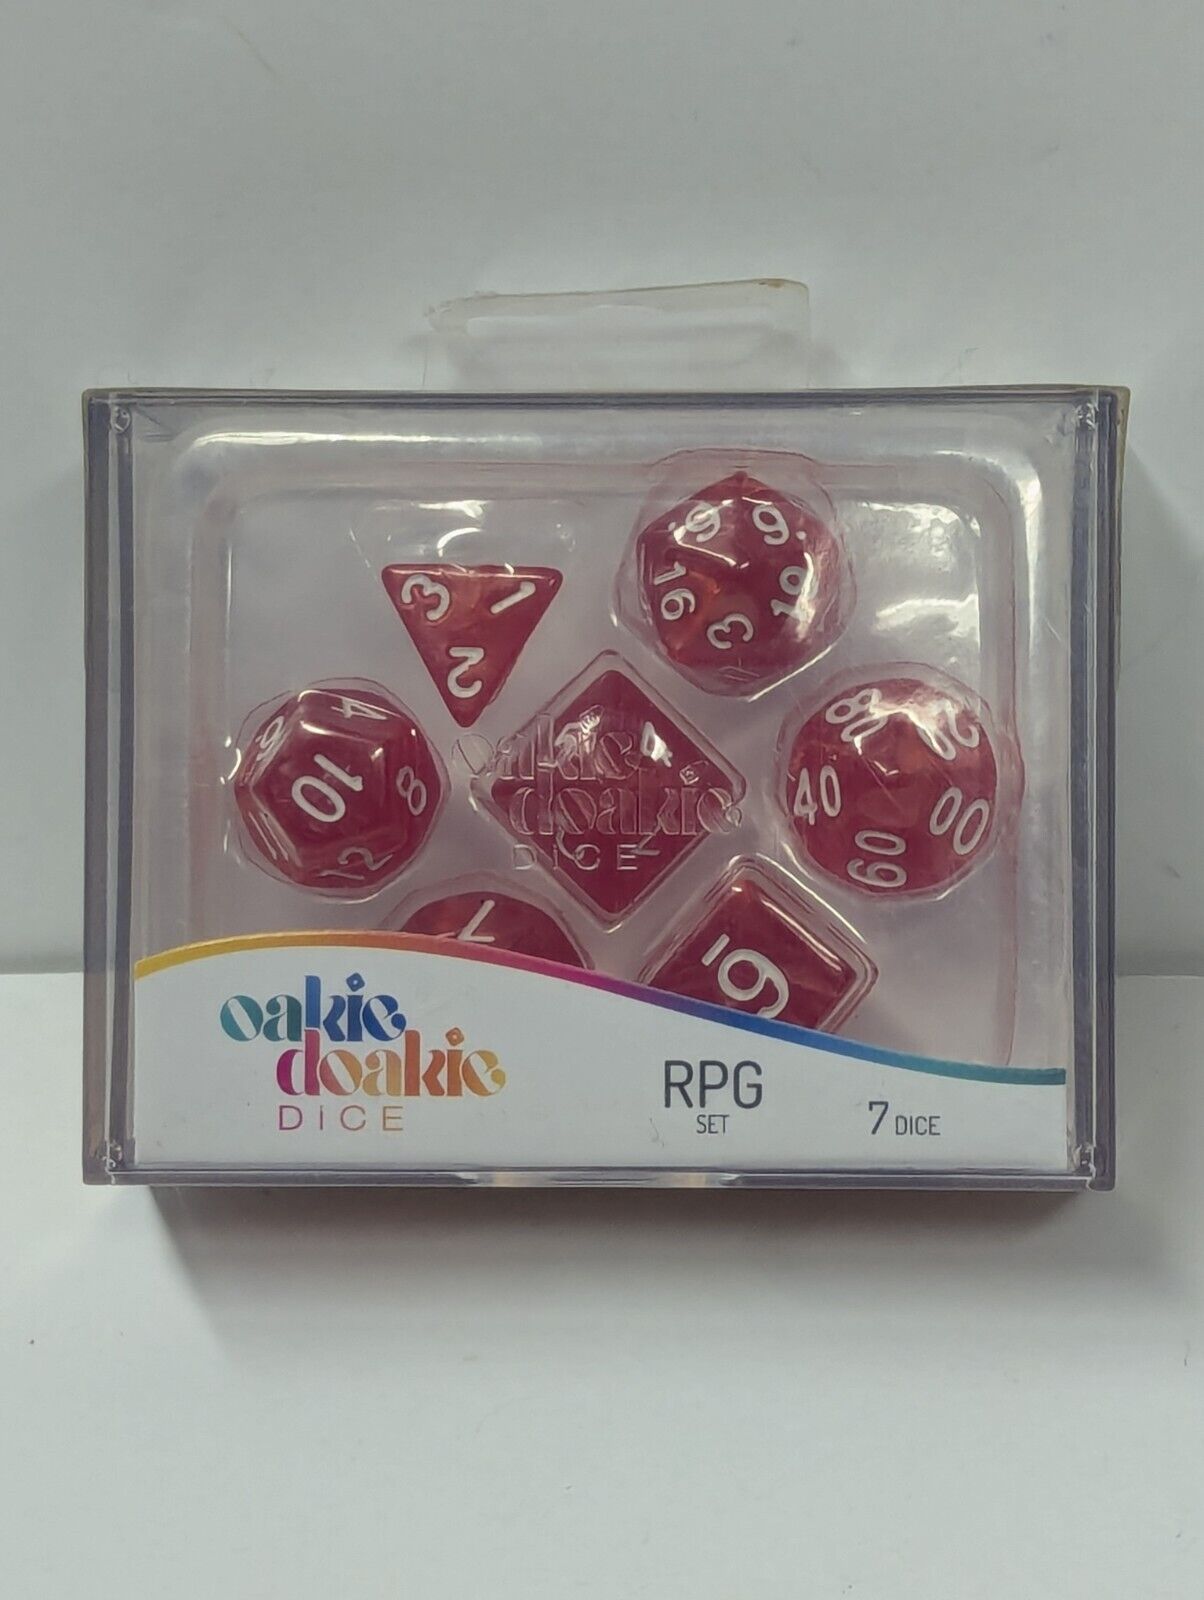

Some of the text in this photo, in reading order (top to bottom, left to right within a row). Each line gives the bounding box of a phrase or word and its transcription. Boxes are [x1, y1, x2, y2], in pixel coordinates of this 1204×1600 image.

[401, 573, 450, 622] 3
[490, 580, 537, 615] 1
[706, 613, 754, 650] 3
[447, 646, 485, 699] 2
[291, 753, 363, 823] 10
[396, 765, 427, 817] 8
[793, 765, 842, 826] 40
[929, 786, 990, 856] 00
[456, 899, 496, 943] 7
[219, 972, 407, 1042] oakie
[276, 1027, 506, 1097] doakie
[664, 1060, 763, 1110] RPG
[695, 1114, 730, 1134] SET
[868, 1101, 941, 1136] 7 DICE
